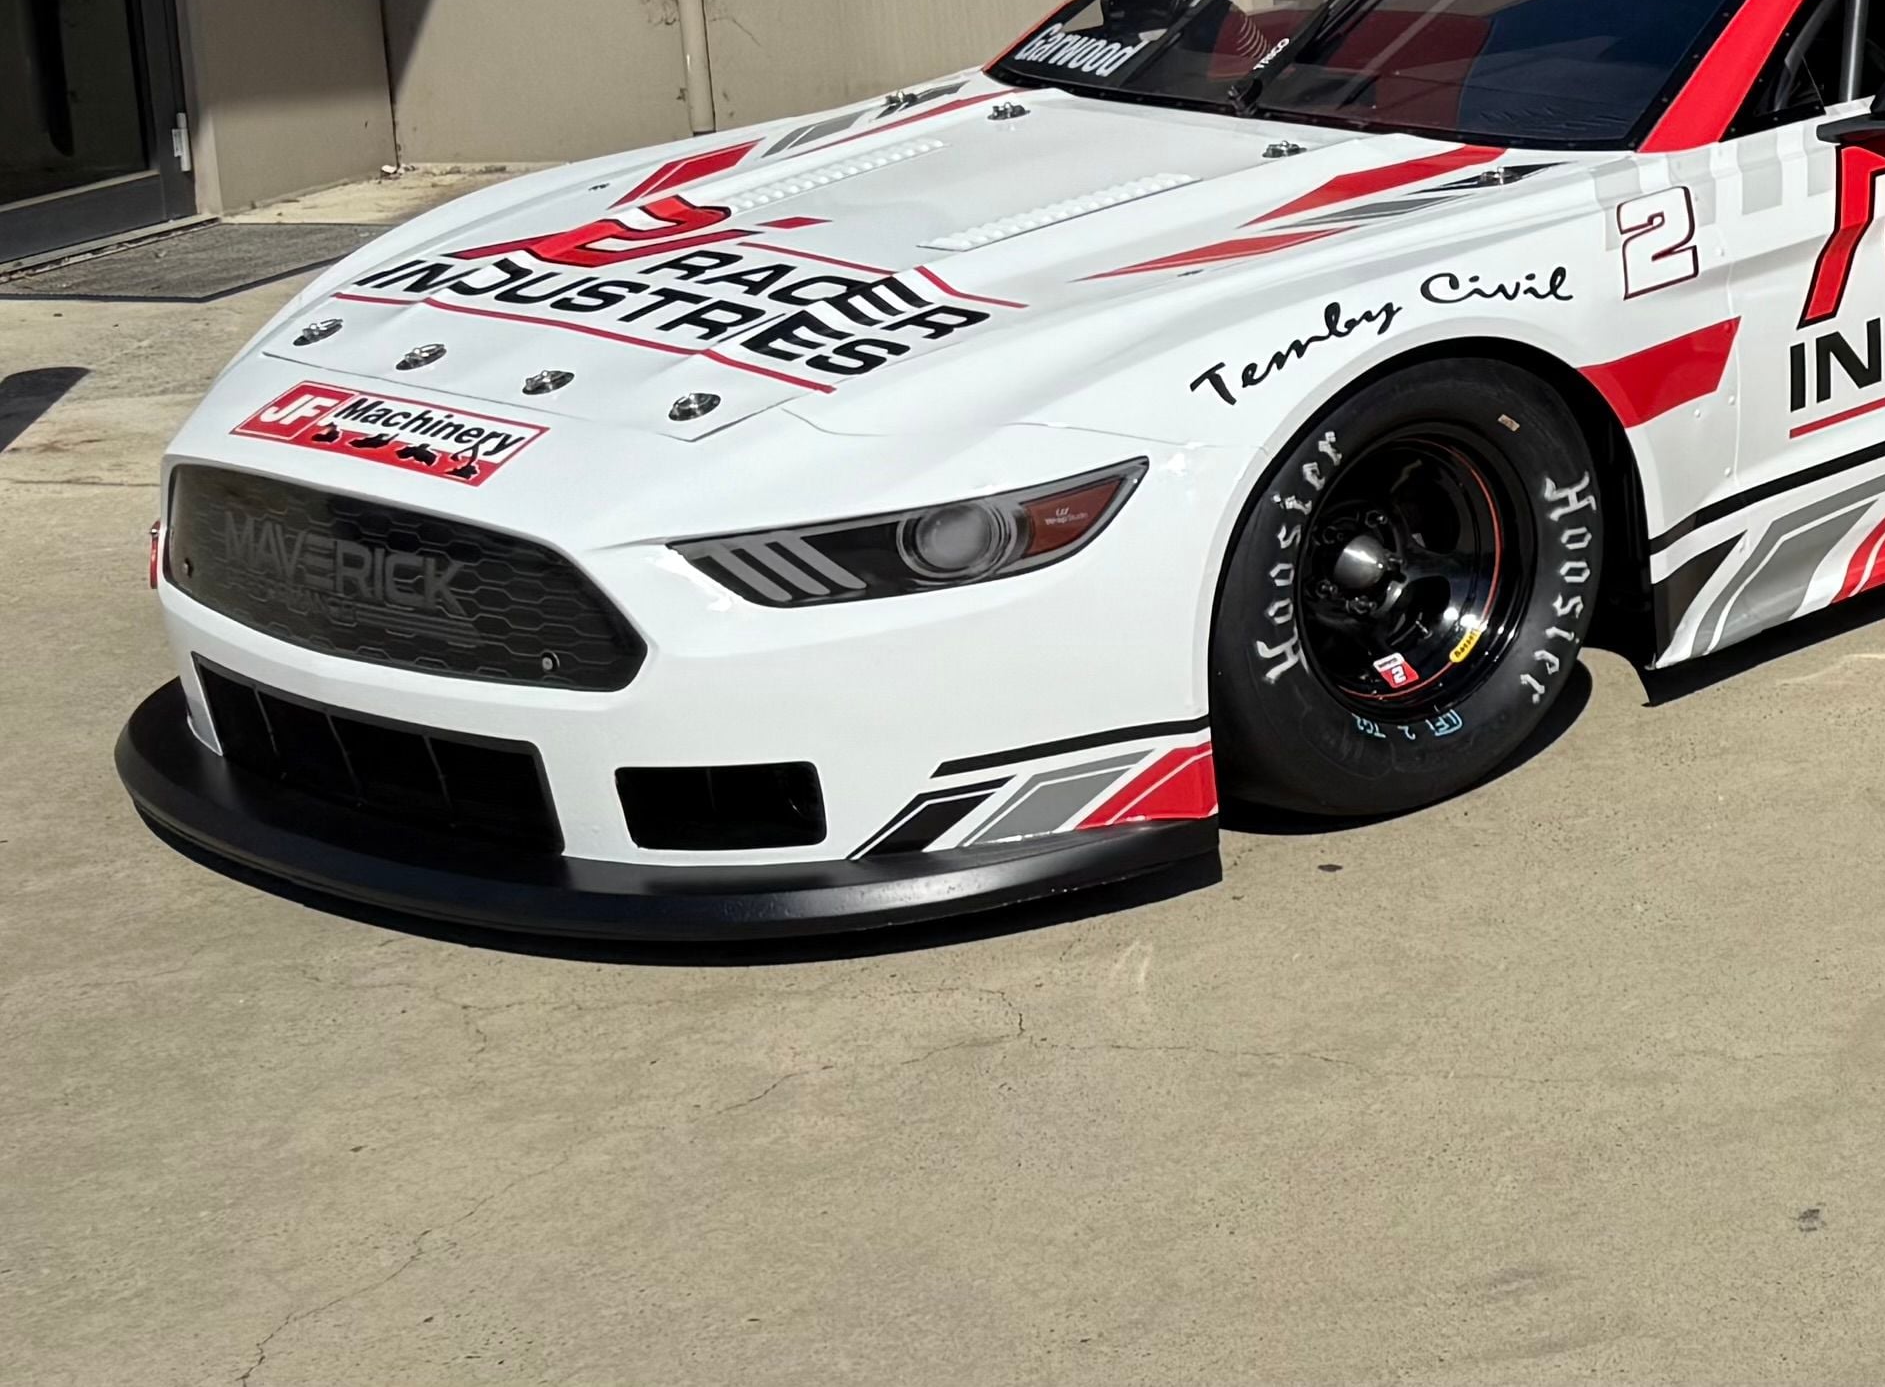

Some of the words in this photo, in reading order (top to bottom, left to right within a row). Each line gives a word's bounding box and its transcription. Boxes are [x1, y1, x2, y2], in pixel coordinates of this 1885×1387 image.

[1014, 22, 1135, 77] Garwood
[657, 249, 992, 343] RACER
[1615, 185, 1700, 301] 2
[352, 258, 912, 378] INDUSTRIES
[1189, 300, 1403, 408] Temby
[1419, 265, 1575, 308] Civil
[255, 395, 328, 431] JF
[335, 393, 530, 459] Machinery
[223, 511, 469, 616] MAVERICK
[1256, 430, 1343, 686] Hoosier
[1519, 470, 1598, 704] Hoosier
